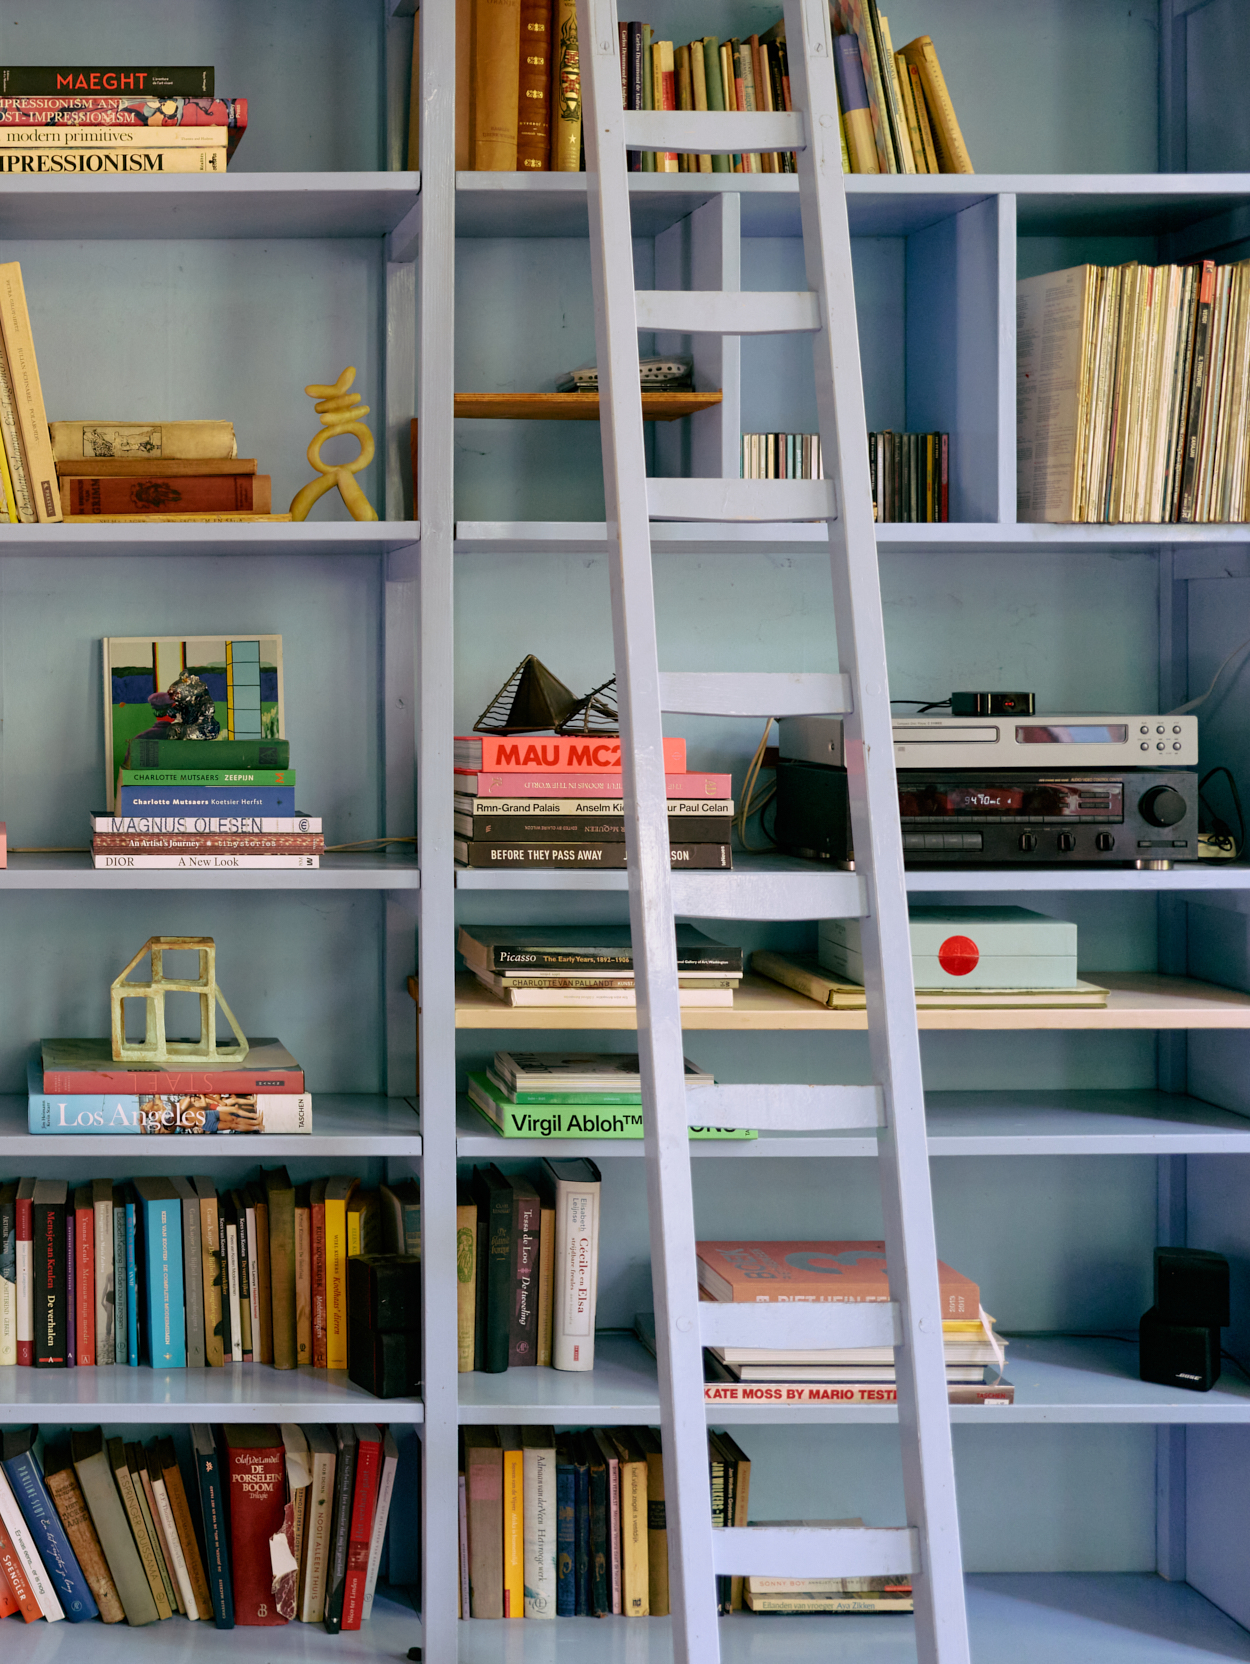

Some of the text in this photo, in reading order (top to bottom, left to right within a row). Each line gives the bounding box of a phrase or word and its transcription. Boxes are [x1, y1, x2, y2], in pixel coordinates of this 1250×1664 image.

[56, 73, 148, 90] MAEGHT
[6, 128, 133, 145] modern primitives
[495, 744, 560, 766] MAU
[476, 803, 560, 812] Rmn-Grand Palais
[111, 817, 263, 834] MAGNUS OLESEN
[105, 856, 239, 867] DIOR A New Look
[491, 850, 603, 861] BEFORE THEY PASS AWAY
[499, 951, 537, 964] Picasso
[128, 1073, 213, 1092] STAEL
[57, 1102, 206, 1130] Los Angeles
[512, 1113, 643, 1136] Virgil Abloh™
[46, 1211, 57, 1347] Mensje van Keulen De verhalen
[703, 1387, 854, 1401] KATE MOSS BY MARIO
[250, 1465, 265, 1474] DE
[231, 1472, 282, 1483] PORSELEIN
[242, 1483, 274, 1492] BOOM
[762, 1601, 793, 1609] Eilanden
[808, 1602, 834, 1611] vroeger
[836, 1601, 851, 1611] Aya
[852, 1601, 876, 1609] Zikken
